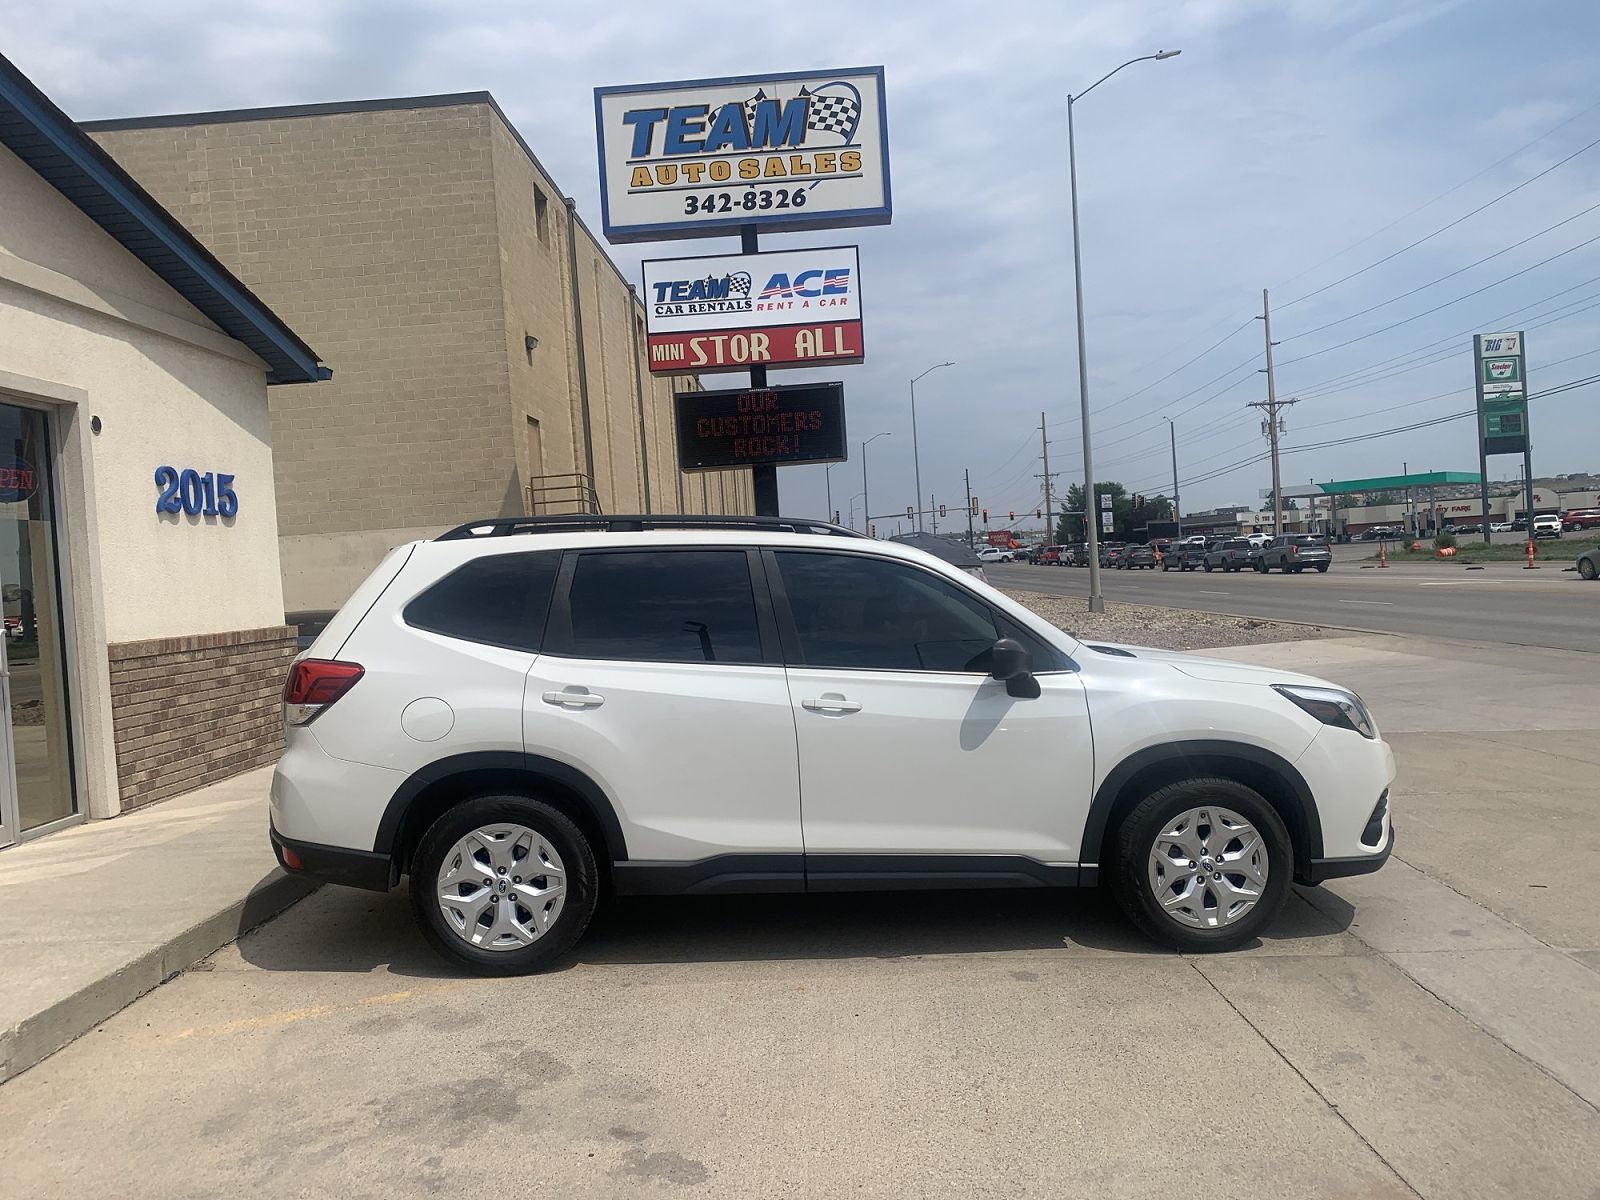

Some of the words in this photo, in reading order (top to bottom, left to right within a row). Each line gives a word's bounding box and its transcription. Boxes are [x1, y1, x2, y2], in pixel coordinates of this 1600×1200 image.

[623, 96, 812, 158] TEAM
[630, 160, 731, 187] AUTO
[738, 151, 863, 178] SALES
[684, 188, 807, 215] 342-8326
[653, 277, 731, 303] TEAM
[757, 268, 850, 300] ACE
[655, 304, 684, 315] CAR
[688, 300, 752, 314] RENTALS
[757, 302, 794, 311] RENT
[802, 300, 810, 308] A
[819, 297, 848, 307] CAR
[652, 343, 684, 362] MINI
[689, 332, 771, 366] STOR
[795, 326, 855, 358] ALL
[1484, 338, 1503, 352] BIG
[736, 391, 779, 412] OUR
[696, 410, 823, 438] CUSTOMERS
[734, 434, 800, 458] ROCK!
[0, 468, 33, 490] PEN
[154, 465, 239, 518] 2015
